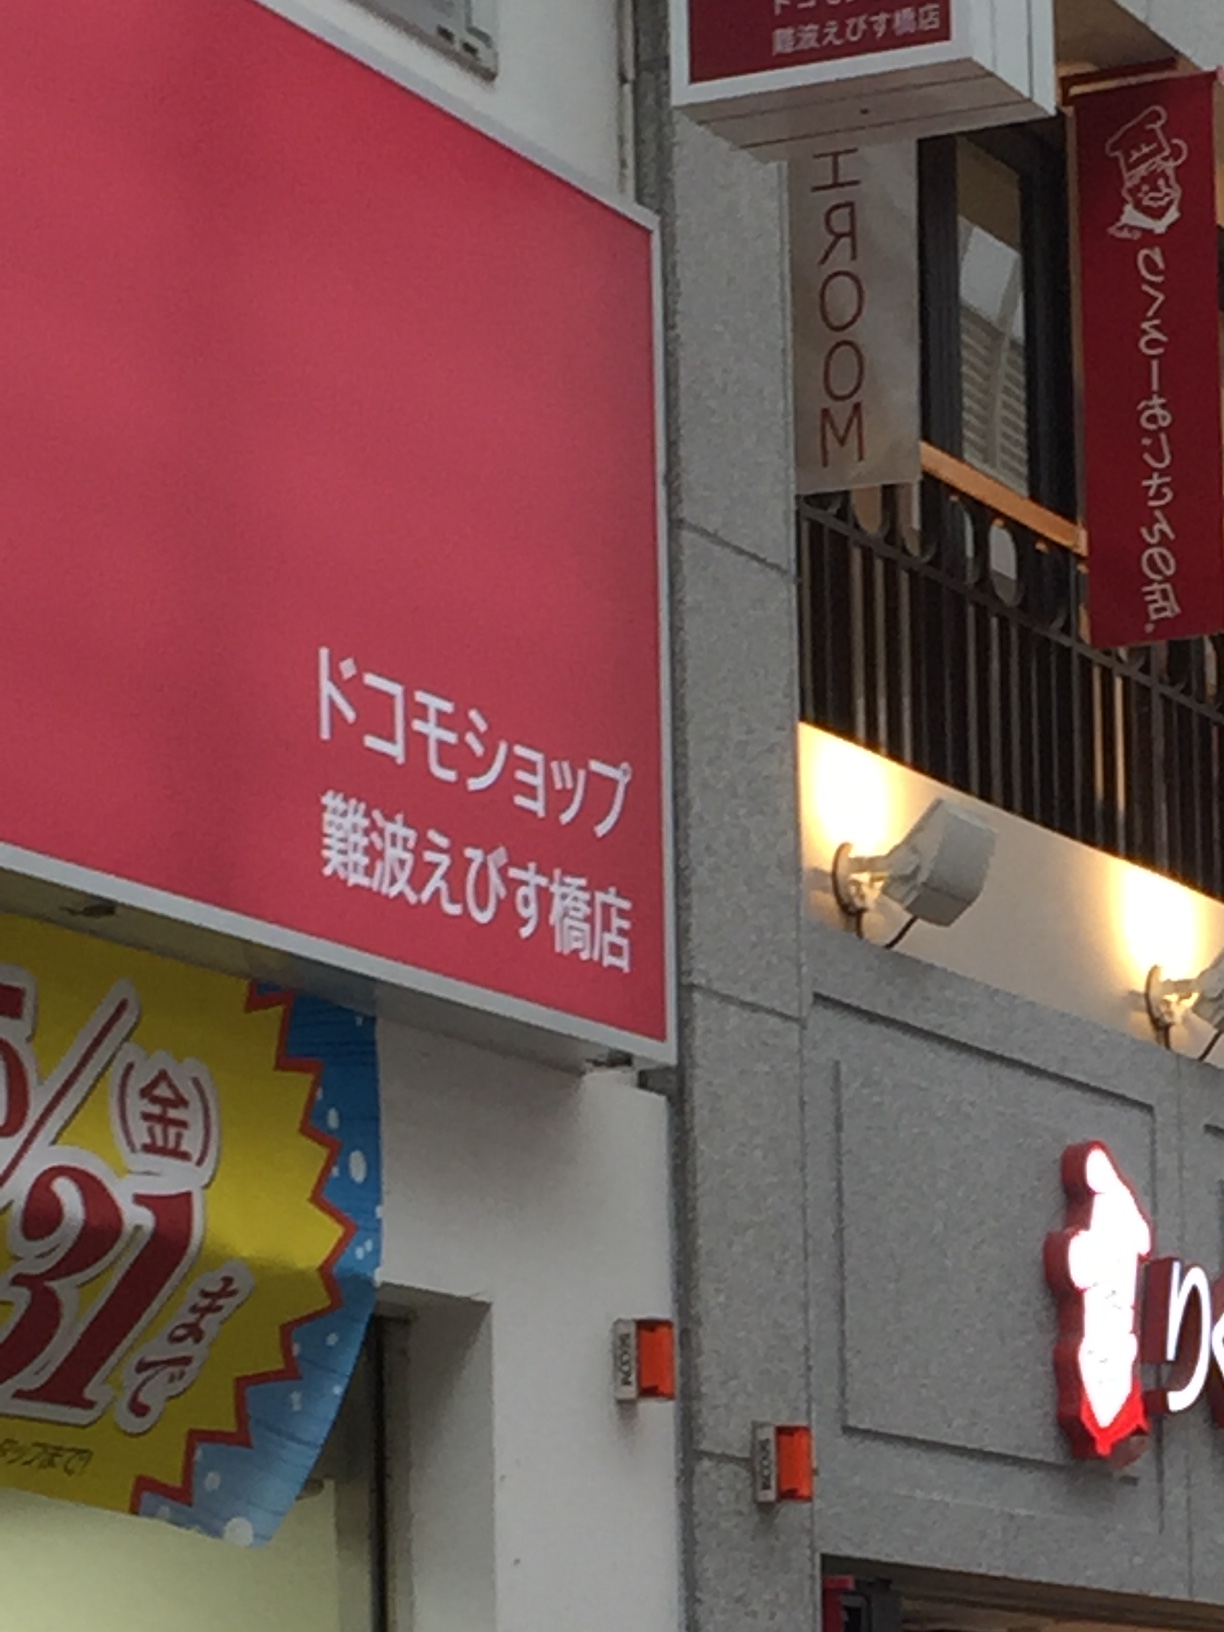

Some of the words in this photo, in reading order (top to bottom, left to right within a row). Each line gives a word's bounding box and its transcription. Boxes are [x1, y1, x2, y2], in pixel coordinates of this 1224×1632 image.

[318, 646, 633, 838] ドコモショップ
[321, 788, 633, 974] 難波えびす橋店
[129, 1276, 239, 1418] まで
